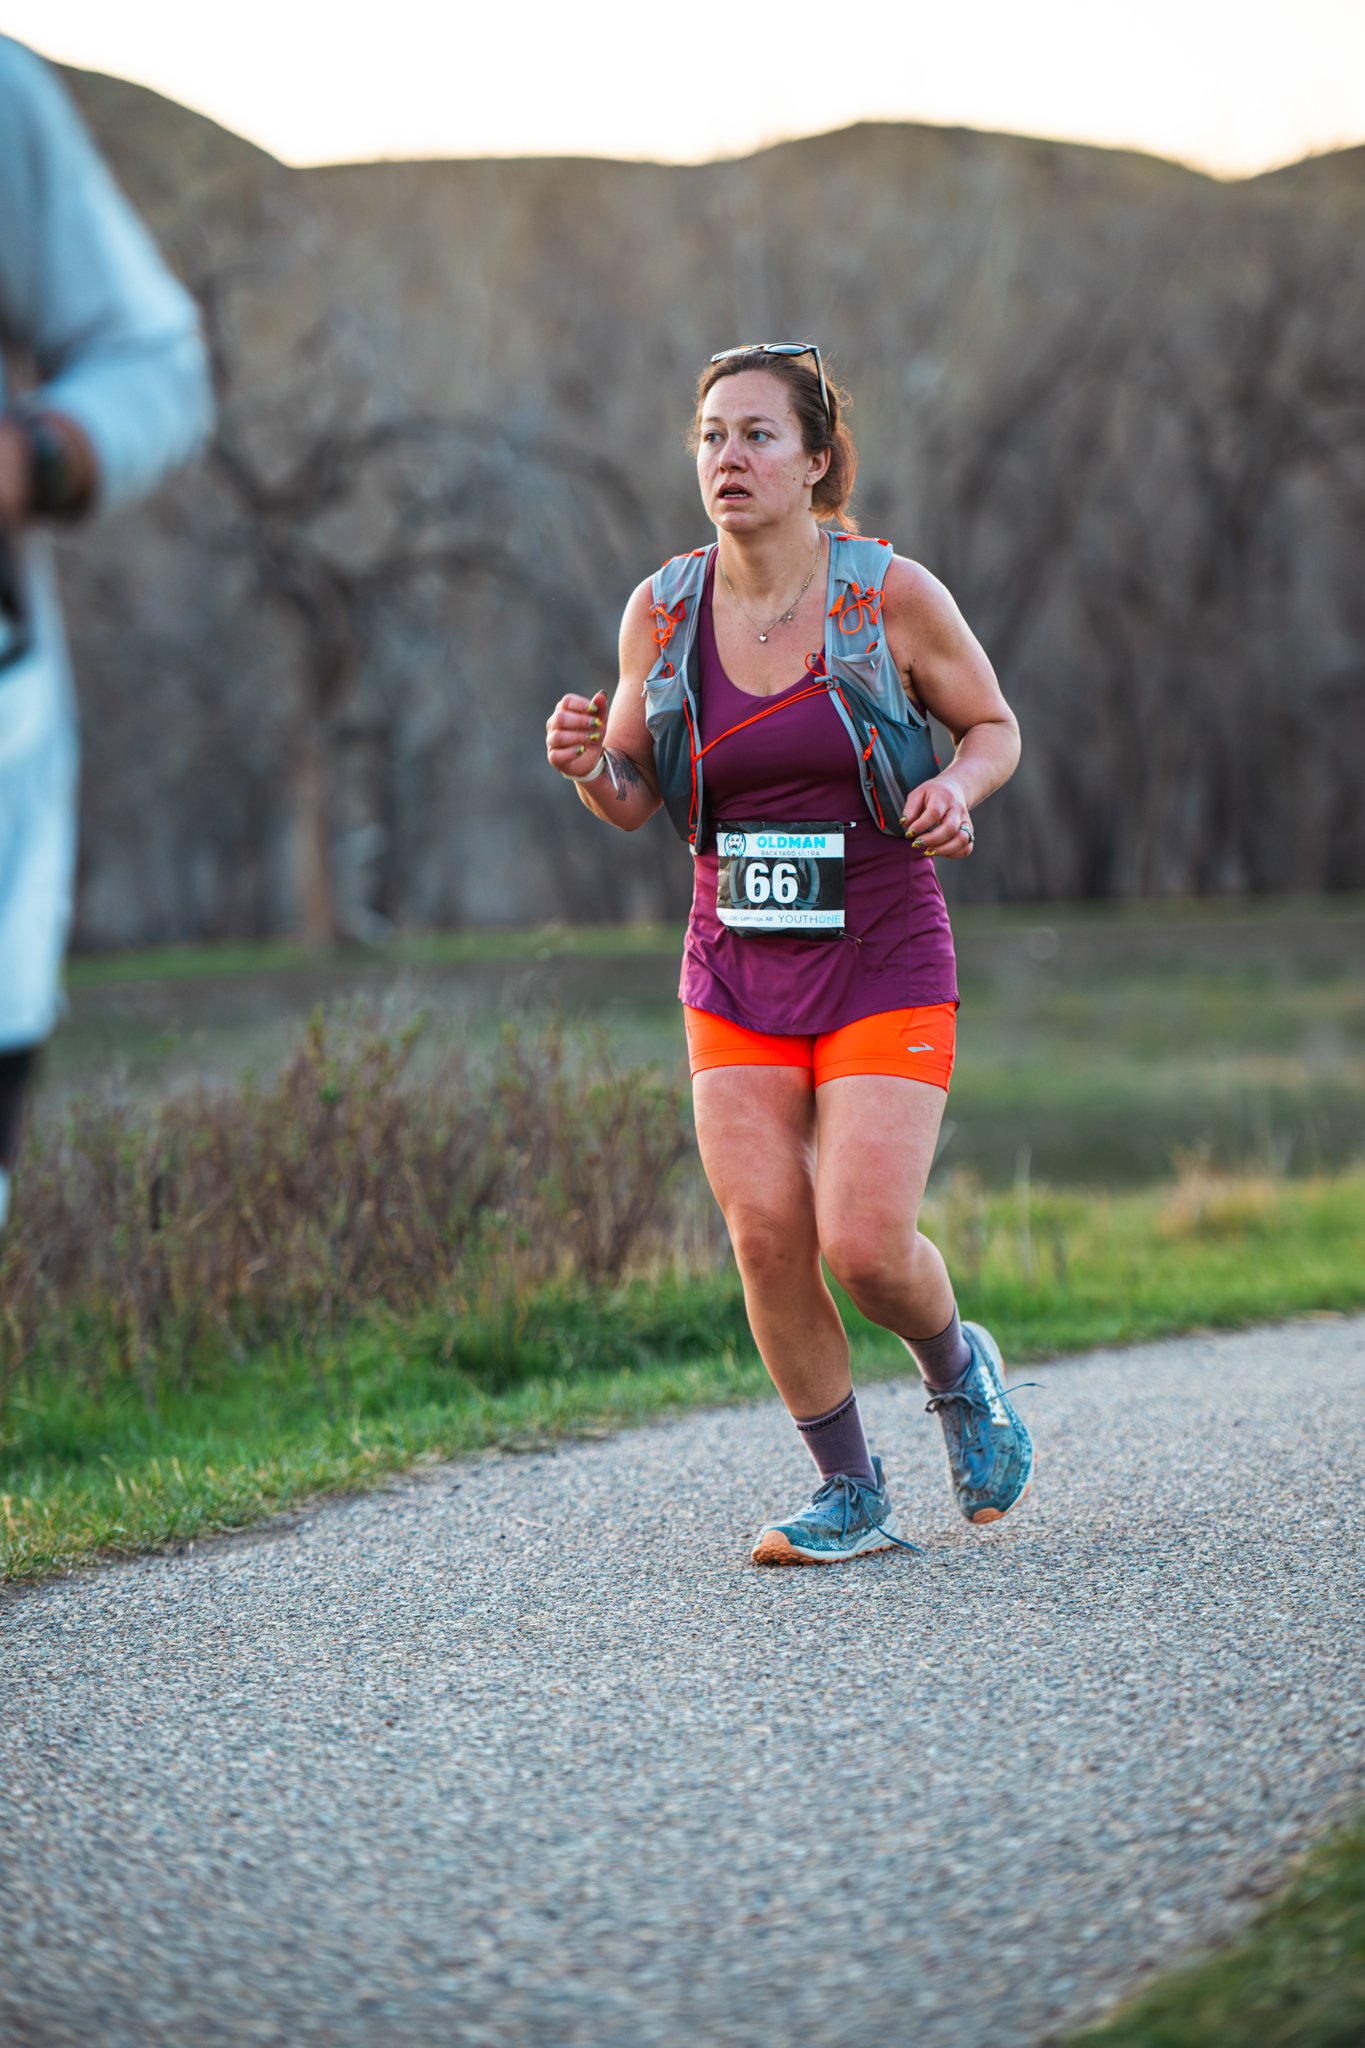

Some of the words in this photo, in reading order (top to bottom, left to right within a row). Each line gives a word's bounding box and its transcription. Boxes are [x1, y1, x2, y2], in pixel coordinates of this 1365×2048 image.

[757, 836, 826, 849] OLDMAN
[745, 862, 799, 904] 66
[778, 914, 841, 924] YOUTHONE
